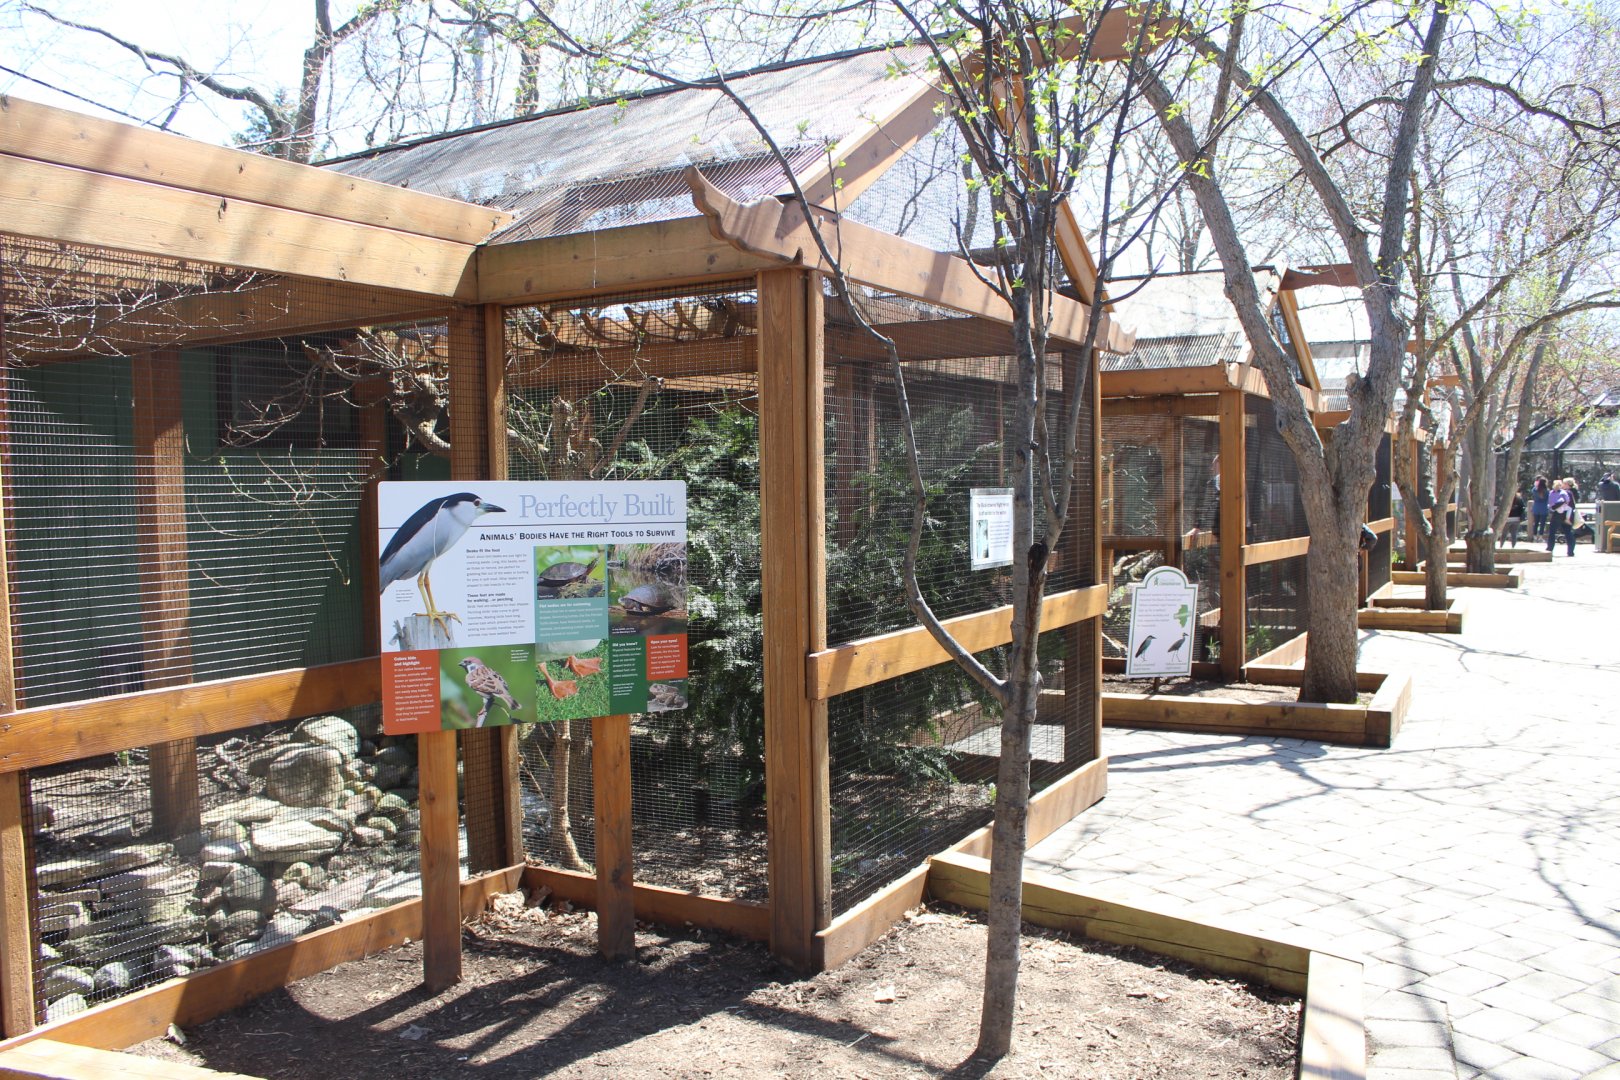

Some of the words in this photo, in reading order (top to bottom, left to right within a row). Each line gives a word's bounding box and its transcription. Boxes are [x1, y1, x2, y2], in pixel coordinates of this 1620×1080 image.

[519, 494, 618, 522] Perfectly
[624, 493, 675, 516] Built
[480, 532, 517, 541] ANIMALS'
[520, 532, 547, 540] BODIES
[549, 531, 569, 539] HAVE
[611, 530, 633, 538] TOOLS
[646, 529, 675, 537] SURVIVE
